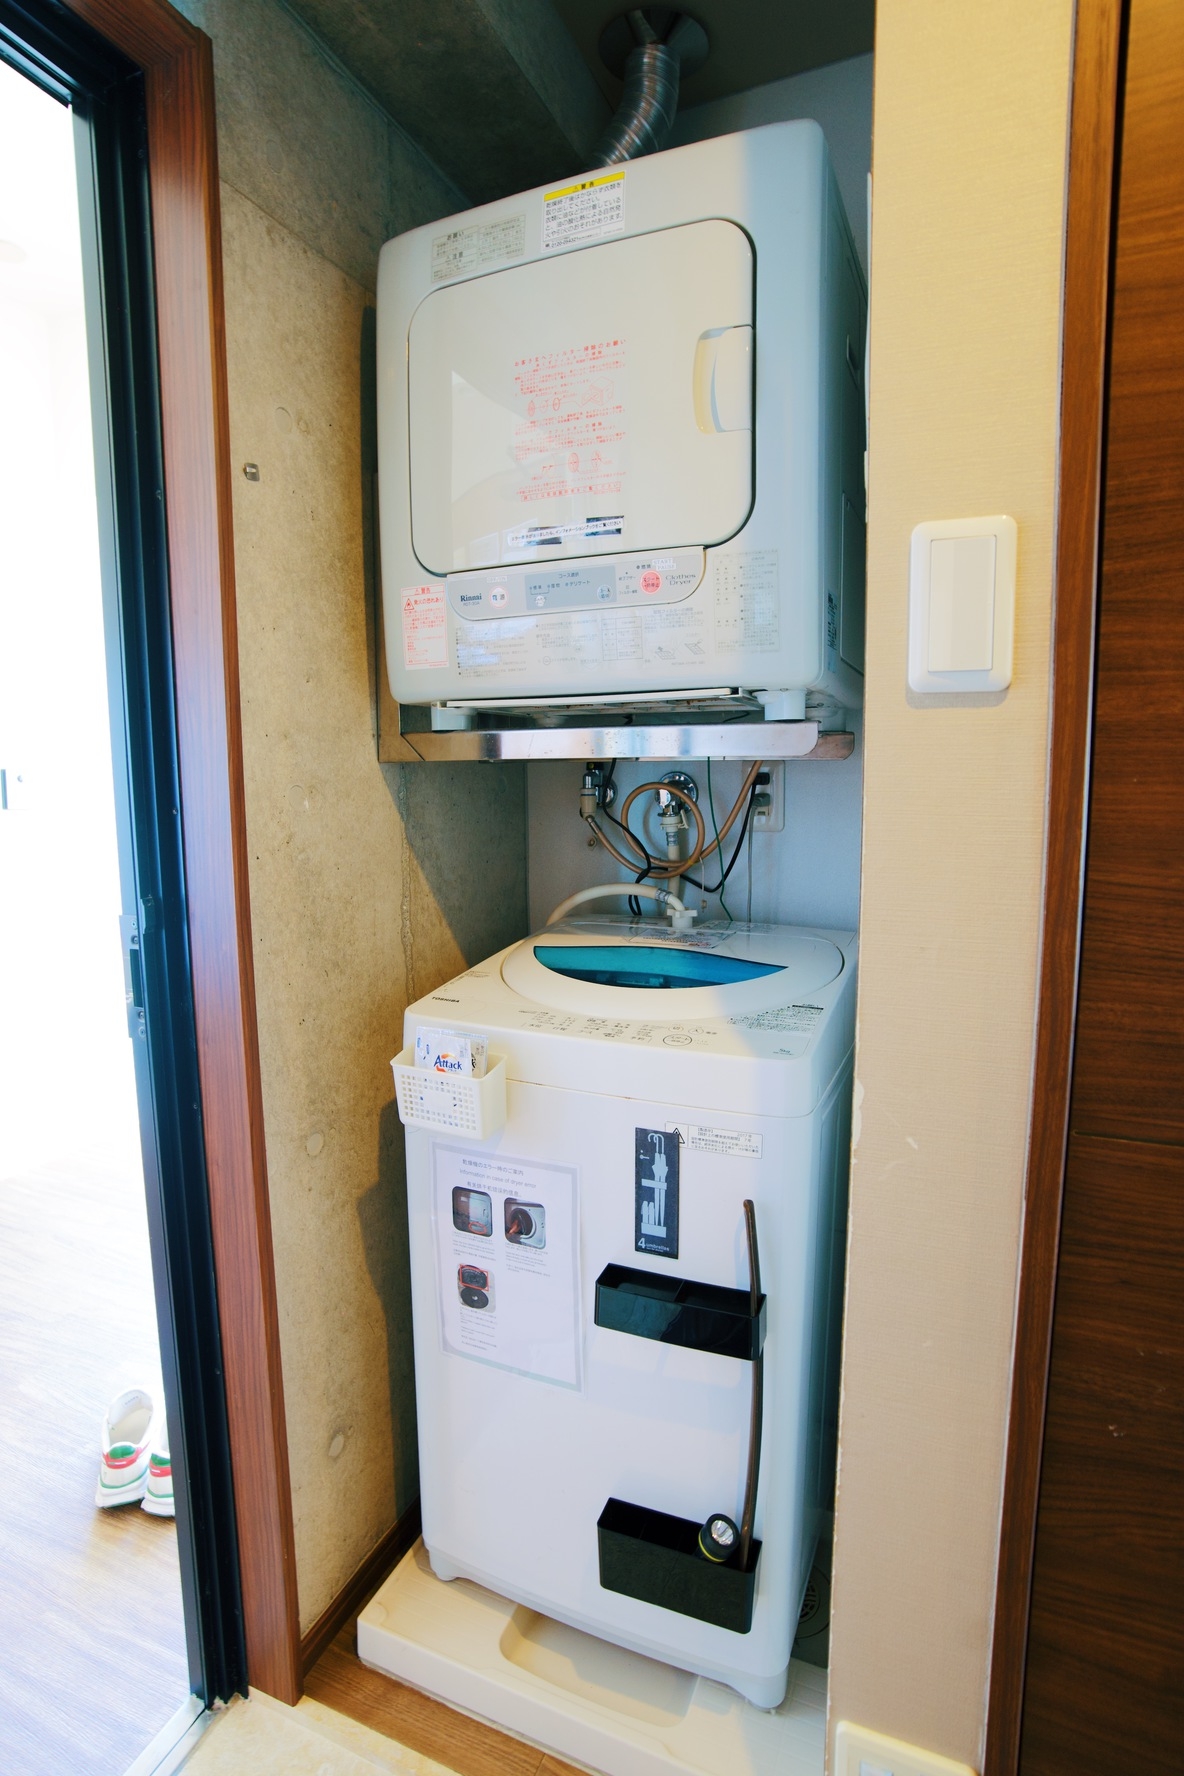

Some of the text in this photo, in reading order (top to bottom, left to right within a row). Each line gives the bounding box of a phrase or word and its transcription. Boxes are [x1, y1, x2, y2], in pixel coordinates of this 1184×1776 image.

[460, 593, 482, 602] Rinnai
[434, 1055, 462, 1070] Attack
[638, 1237, 646, 1249] 4
